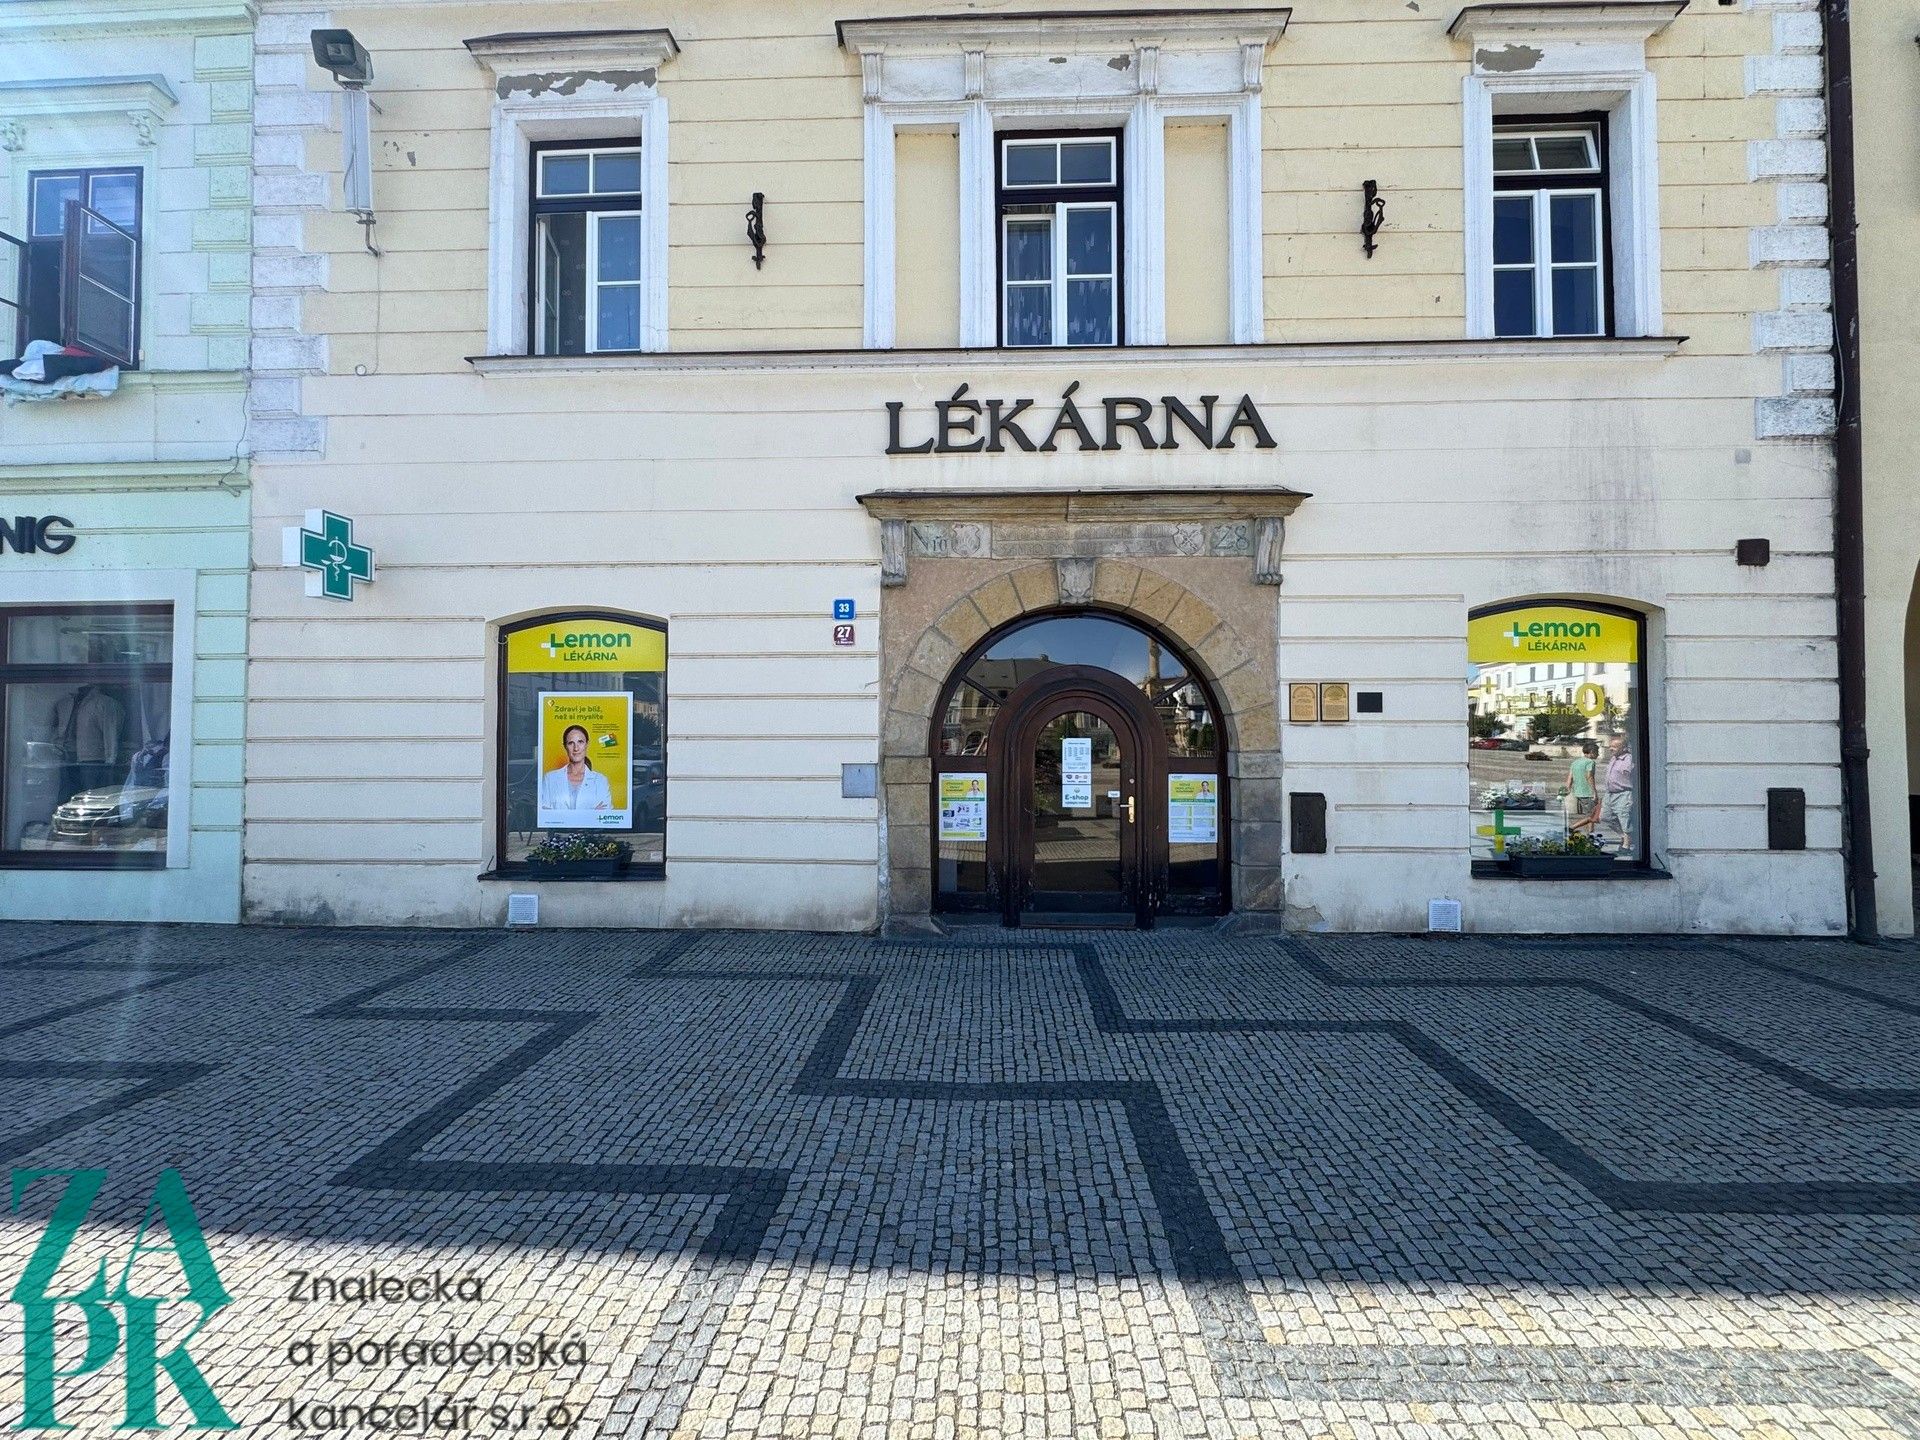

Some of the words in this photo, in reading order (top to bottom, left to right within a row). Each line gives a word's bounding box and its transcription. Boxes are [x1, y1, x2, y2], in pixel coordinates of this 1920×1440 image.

[885, 380, 1278, 454] LÉKÁRNA
[838, 603, 850, 613] 33
[837, 626, 851, 638] 27
[1513, 621, 1600, 638] Lemon
[550, 632, 632, 648] Lemon
[1528, 640, 1586, 651] LÉKÁRNA
[563, 650, 618, 661] LÉKÁRNA
[1576, 682, 1605, 717] 0
